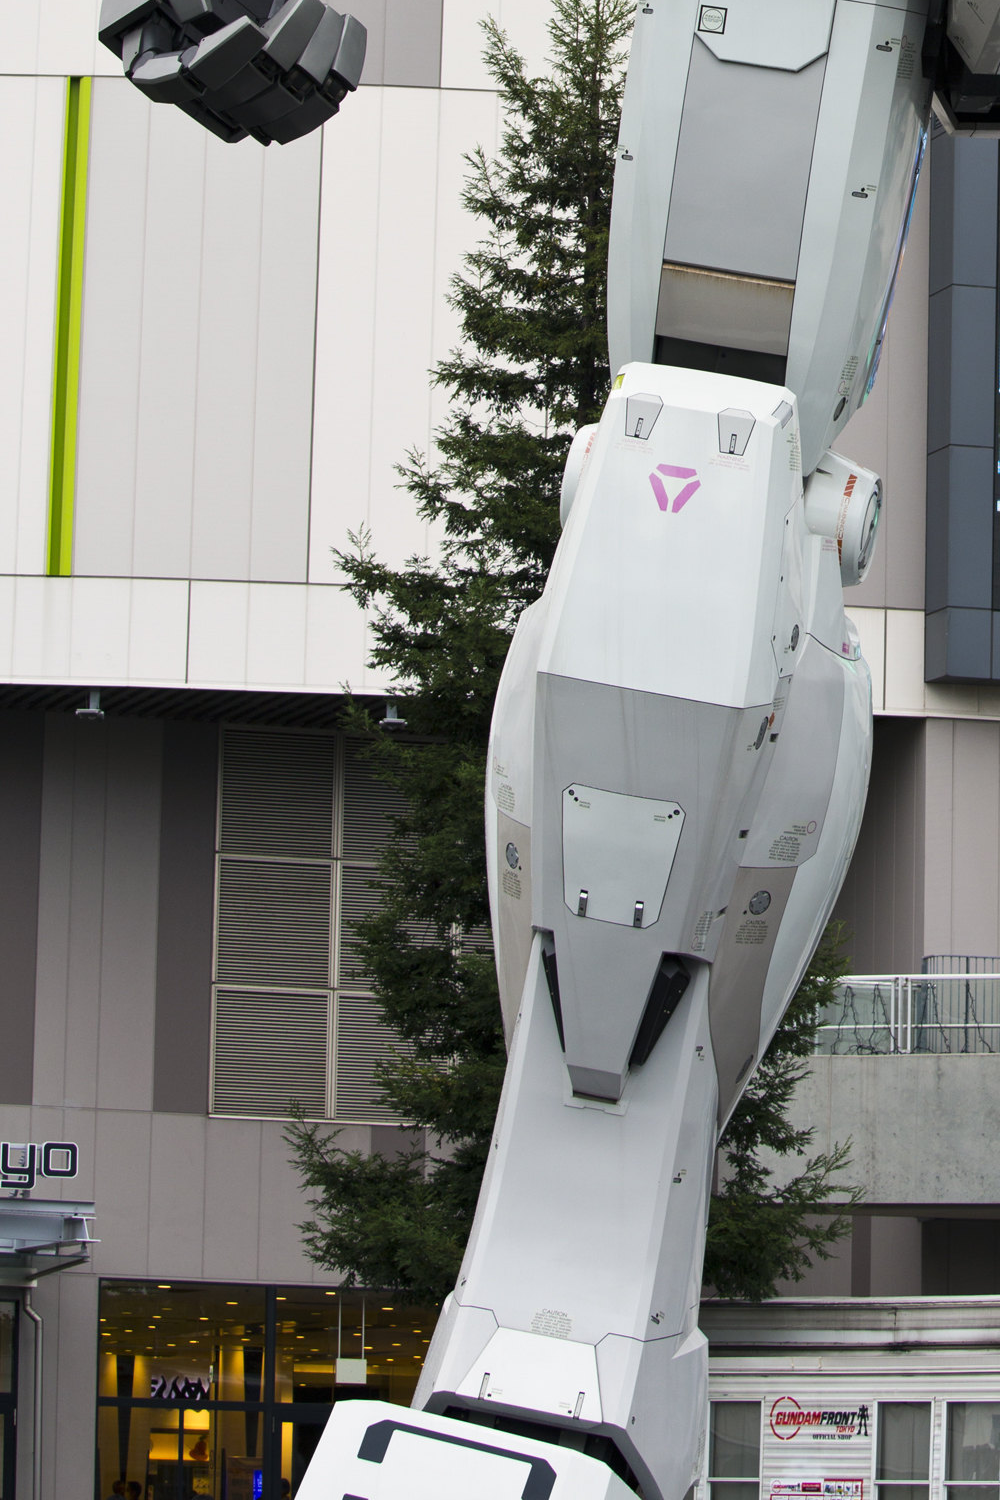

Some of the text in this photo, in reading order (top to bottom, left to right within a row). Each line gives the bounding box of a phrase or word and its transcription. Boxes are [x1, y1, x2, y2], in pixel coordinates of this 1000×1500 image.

[0, 1142, 79, 1190] yo
[542, 1308, 568, 1318] CAUTION
[835, 1425, 856, 1433] TOKYO
